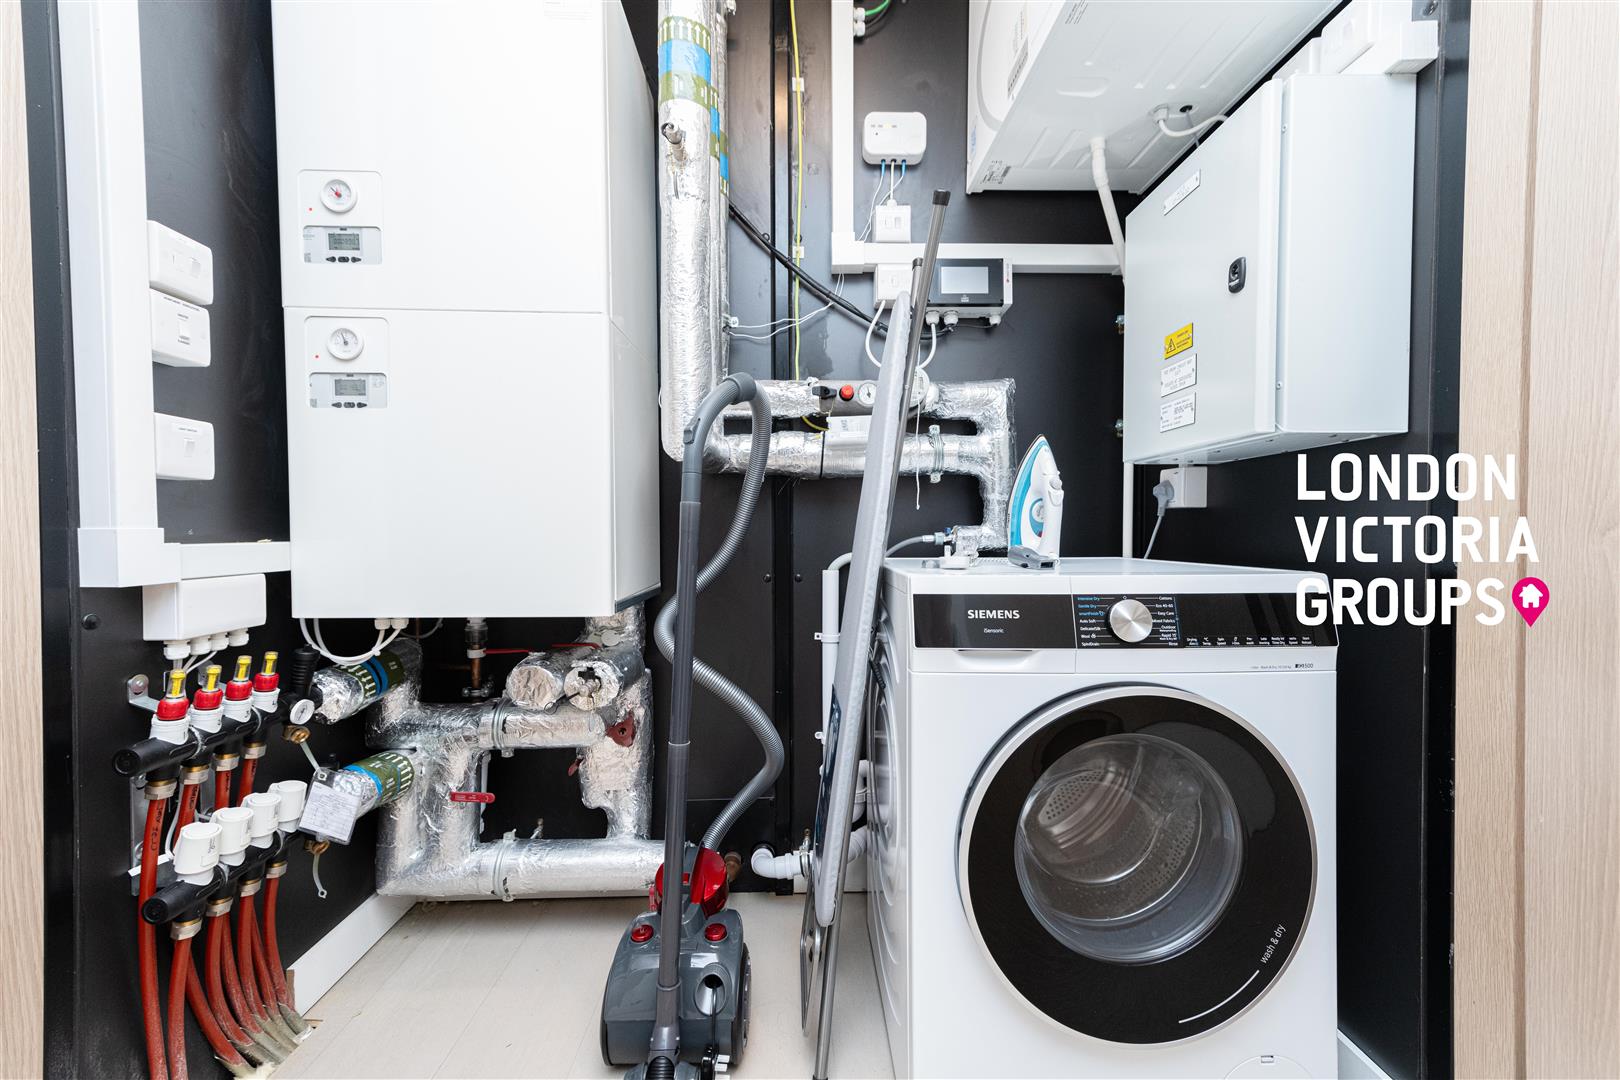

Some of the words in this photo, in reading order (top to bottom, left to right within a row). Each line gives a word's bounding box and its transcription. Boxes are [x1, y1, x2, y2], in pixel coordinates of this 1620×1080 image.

[967, 609, 1021, 620] SIEMENS
[1273, 923, 1287, 938] dry
[1270, 937, 1279, 945] &
[1259, 944, 1276, 964] wash
